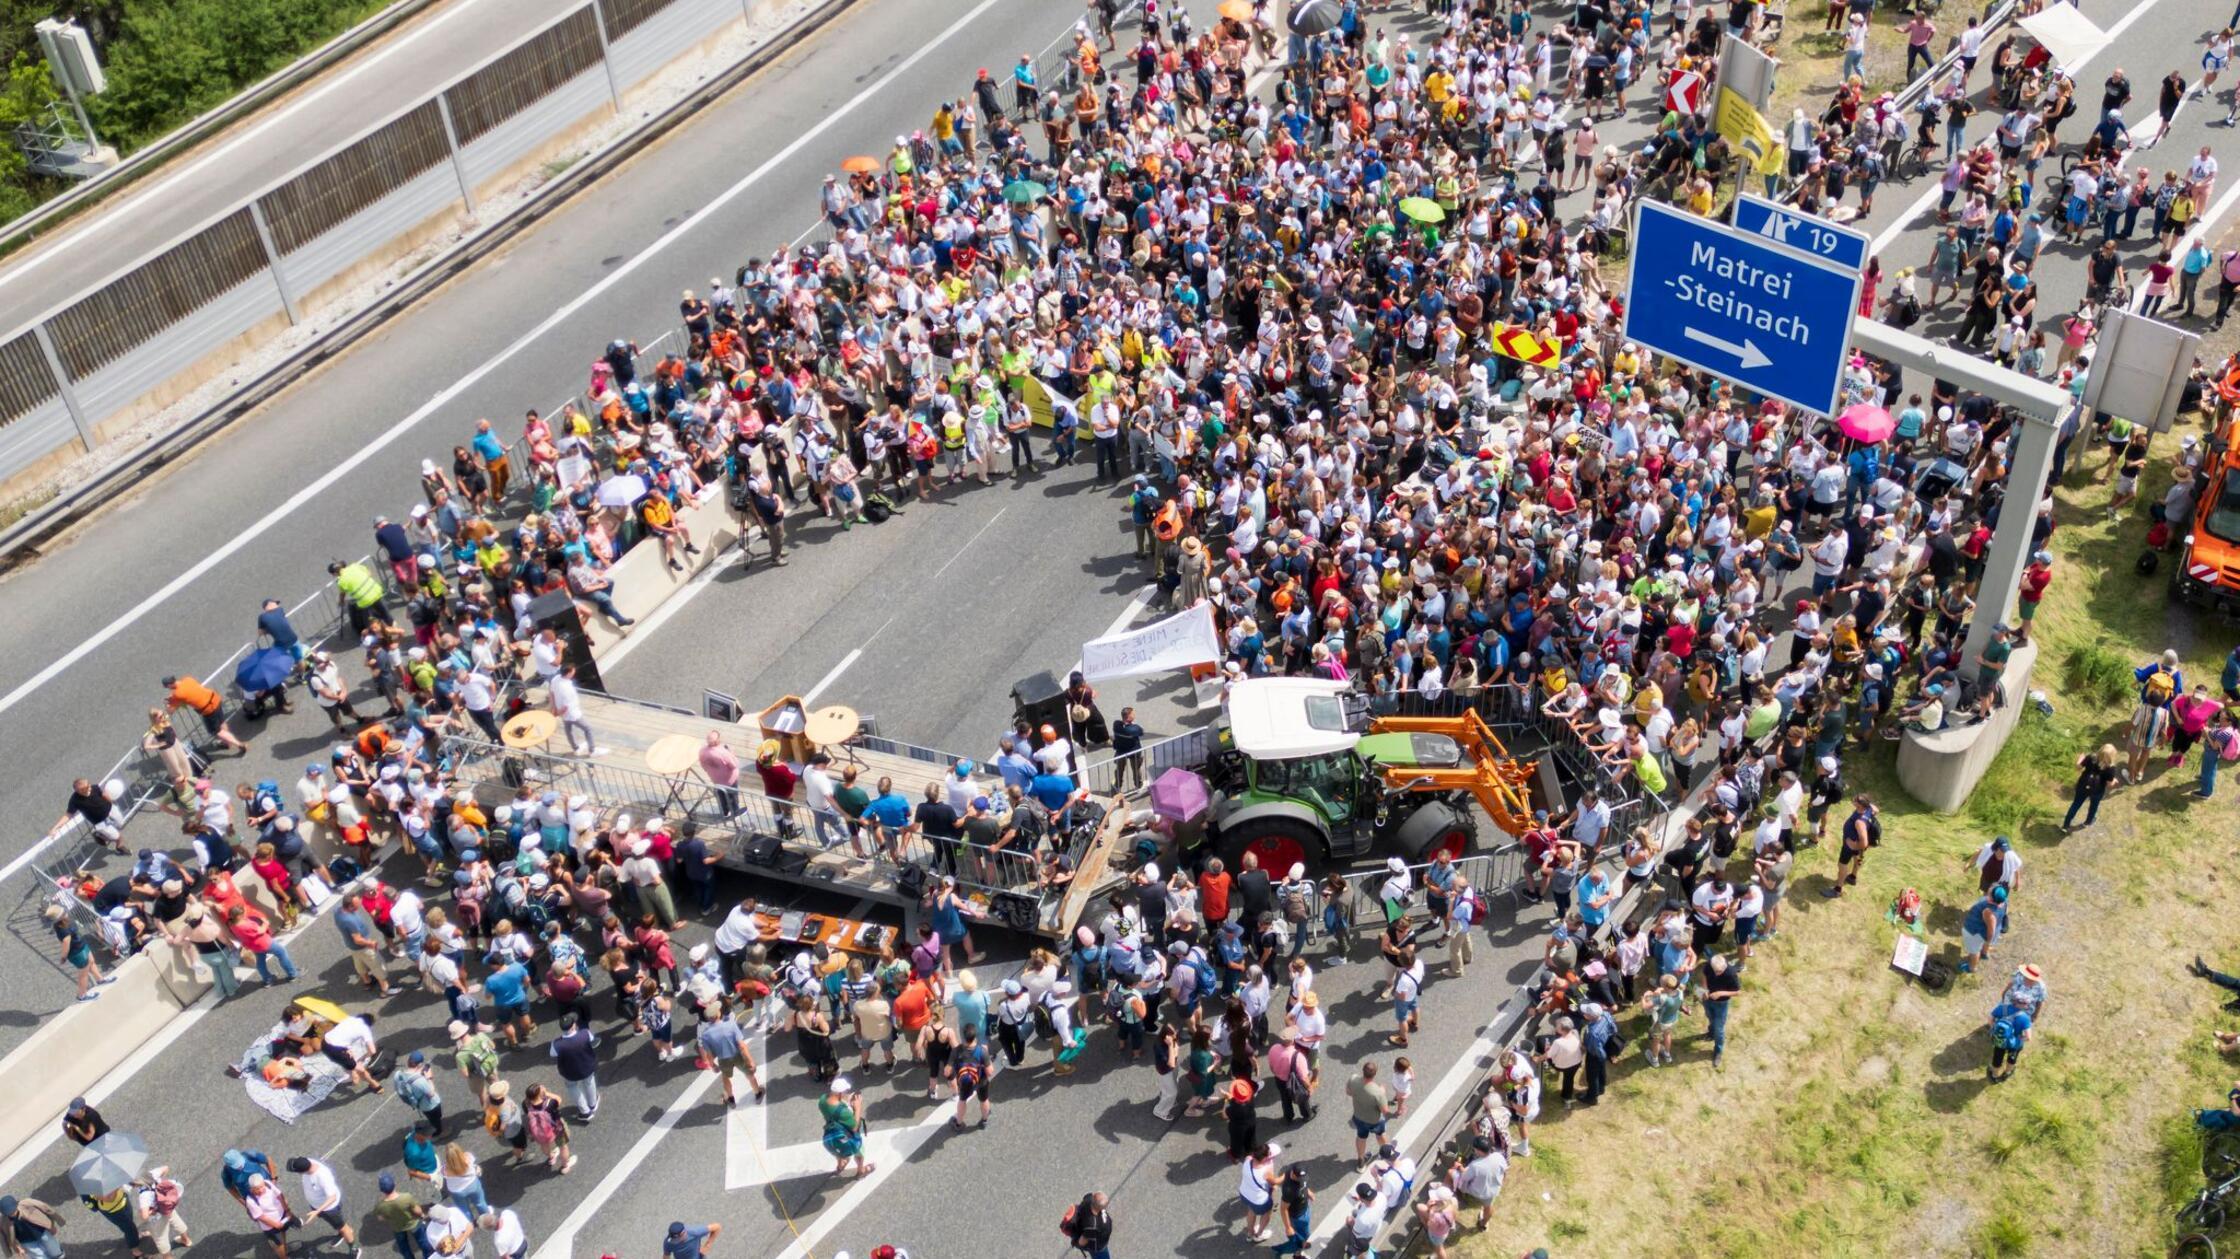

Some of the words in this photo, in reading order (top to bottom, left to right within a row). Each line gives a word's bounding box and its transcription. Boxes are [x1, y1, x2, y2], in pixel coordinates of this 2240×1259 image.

[1691, 240, 1793, 299] Matrei
[1810, 228, 1838, 254] 19
[1664, 274, 1809, 345] -Steinach
